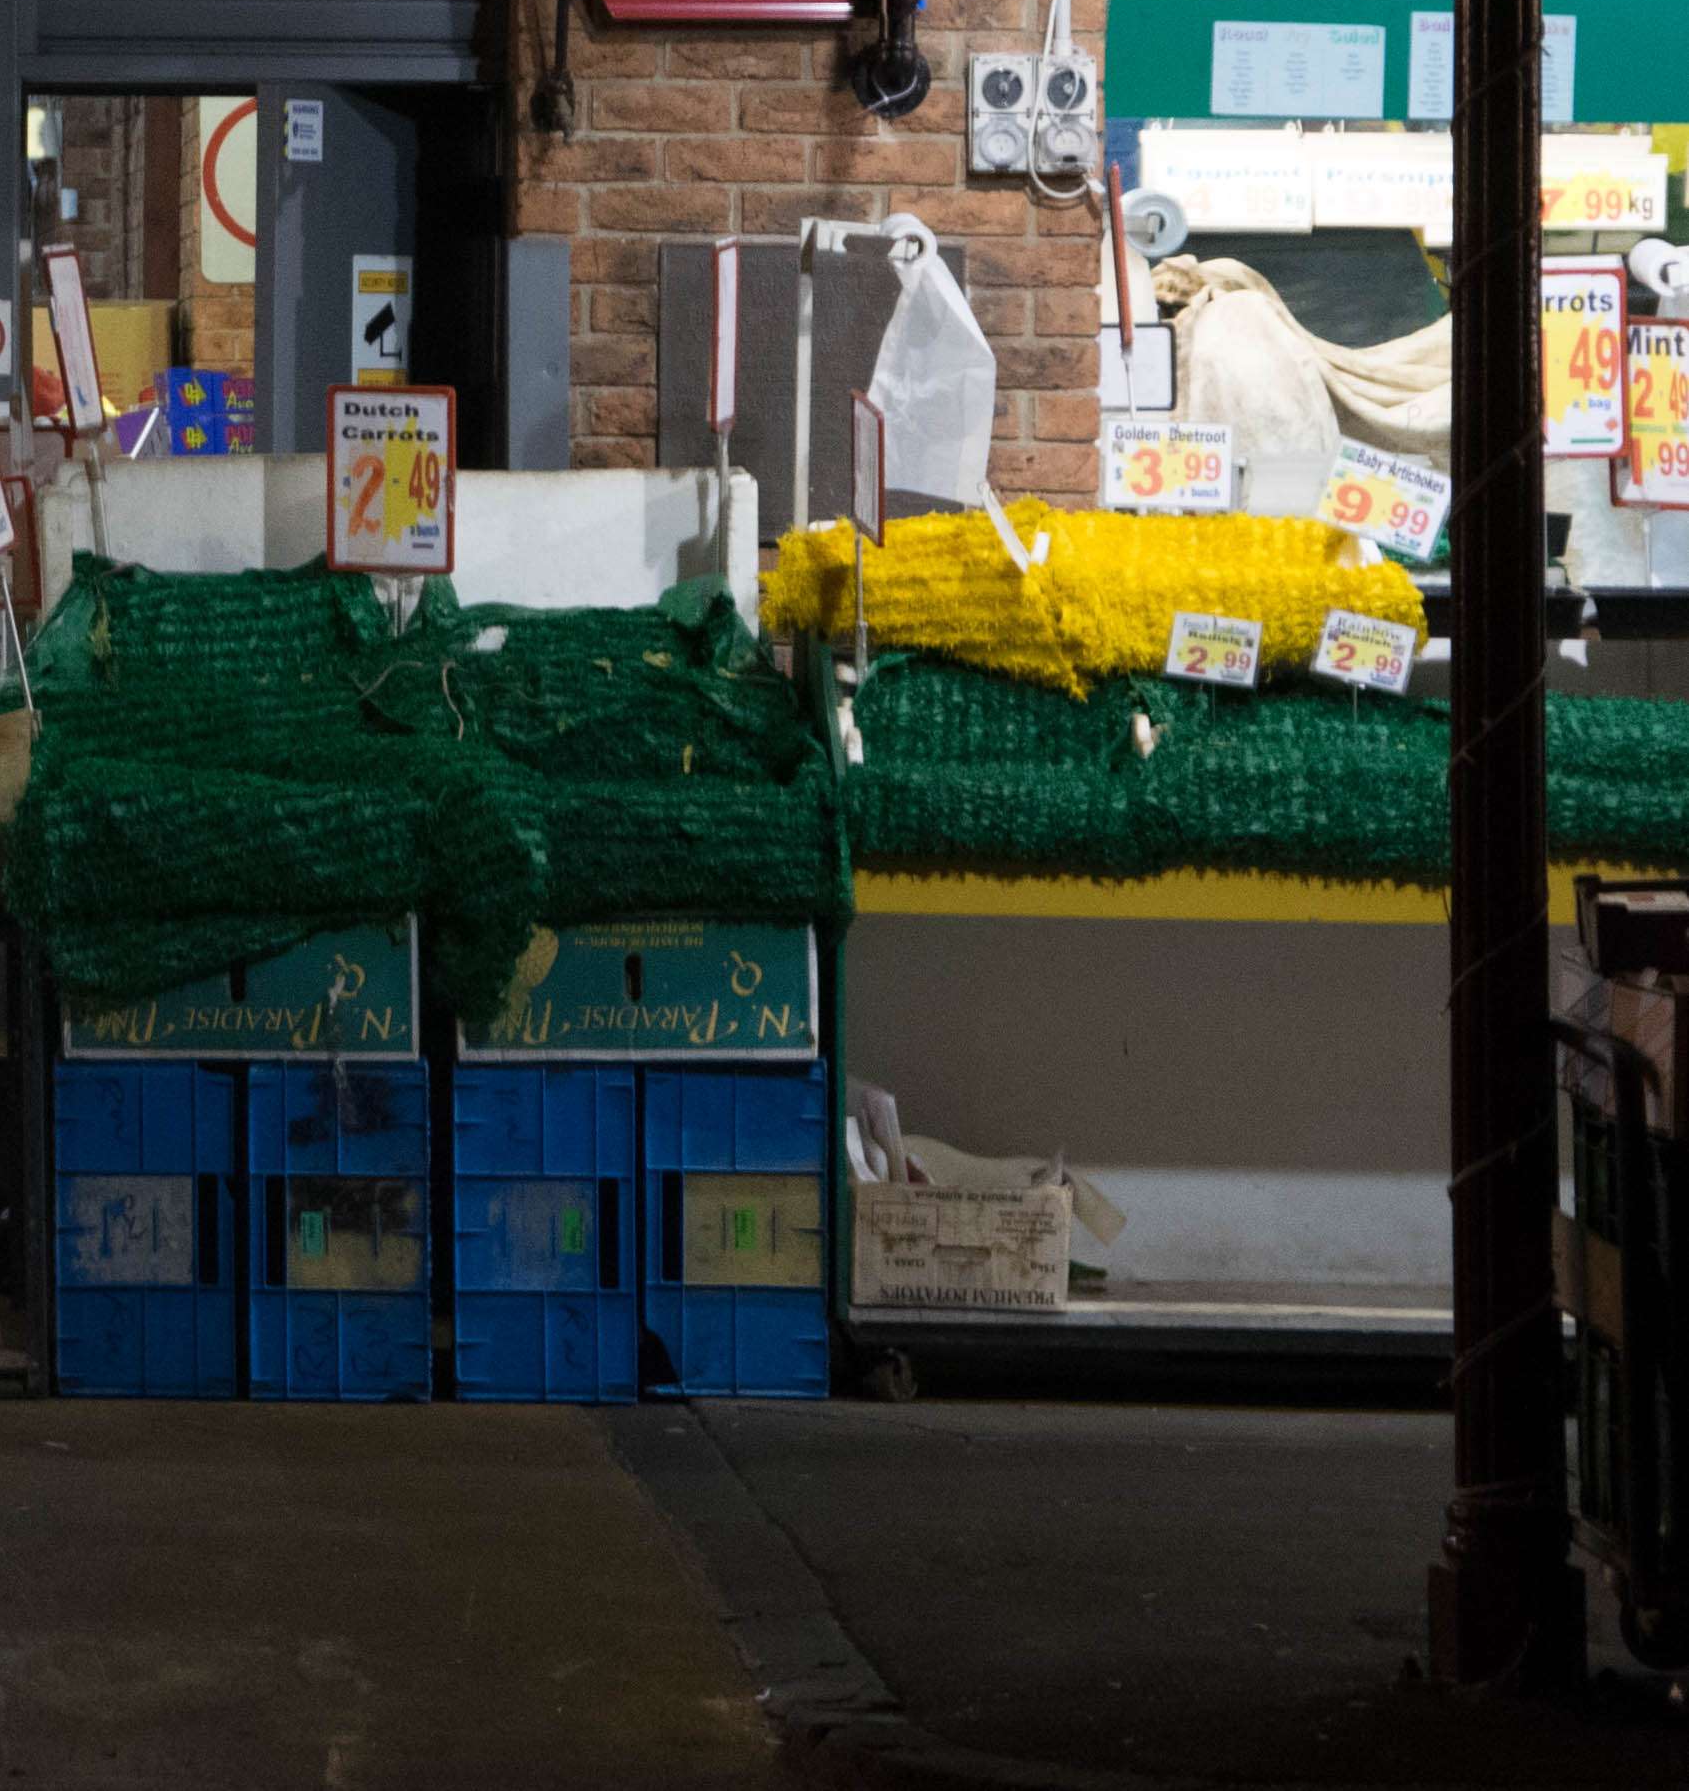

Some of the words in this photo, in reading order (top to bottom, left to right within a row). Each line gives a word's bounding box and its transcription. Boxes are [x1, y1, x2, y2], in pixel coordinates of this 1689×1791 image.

[1628, 192, 1654, 219] kg
[1541, 291, 1613, 314] rrots
[1628, 327, 1686, 357] Mint
[343, 401, 420, 417] Dutch
[342, 425, 440, 442] Carrots
[1114, 424, 1161, 442] Golden
[1356, 448, 1384, 473] Baby
[1388, 459, 1446, 495] Artichokes
[880, 1284, 968, 1302] POTATOES
[973, 1287, 1056, 1306] PREMIUM
